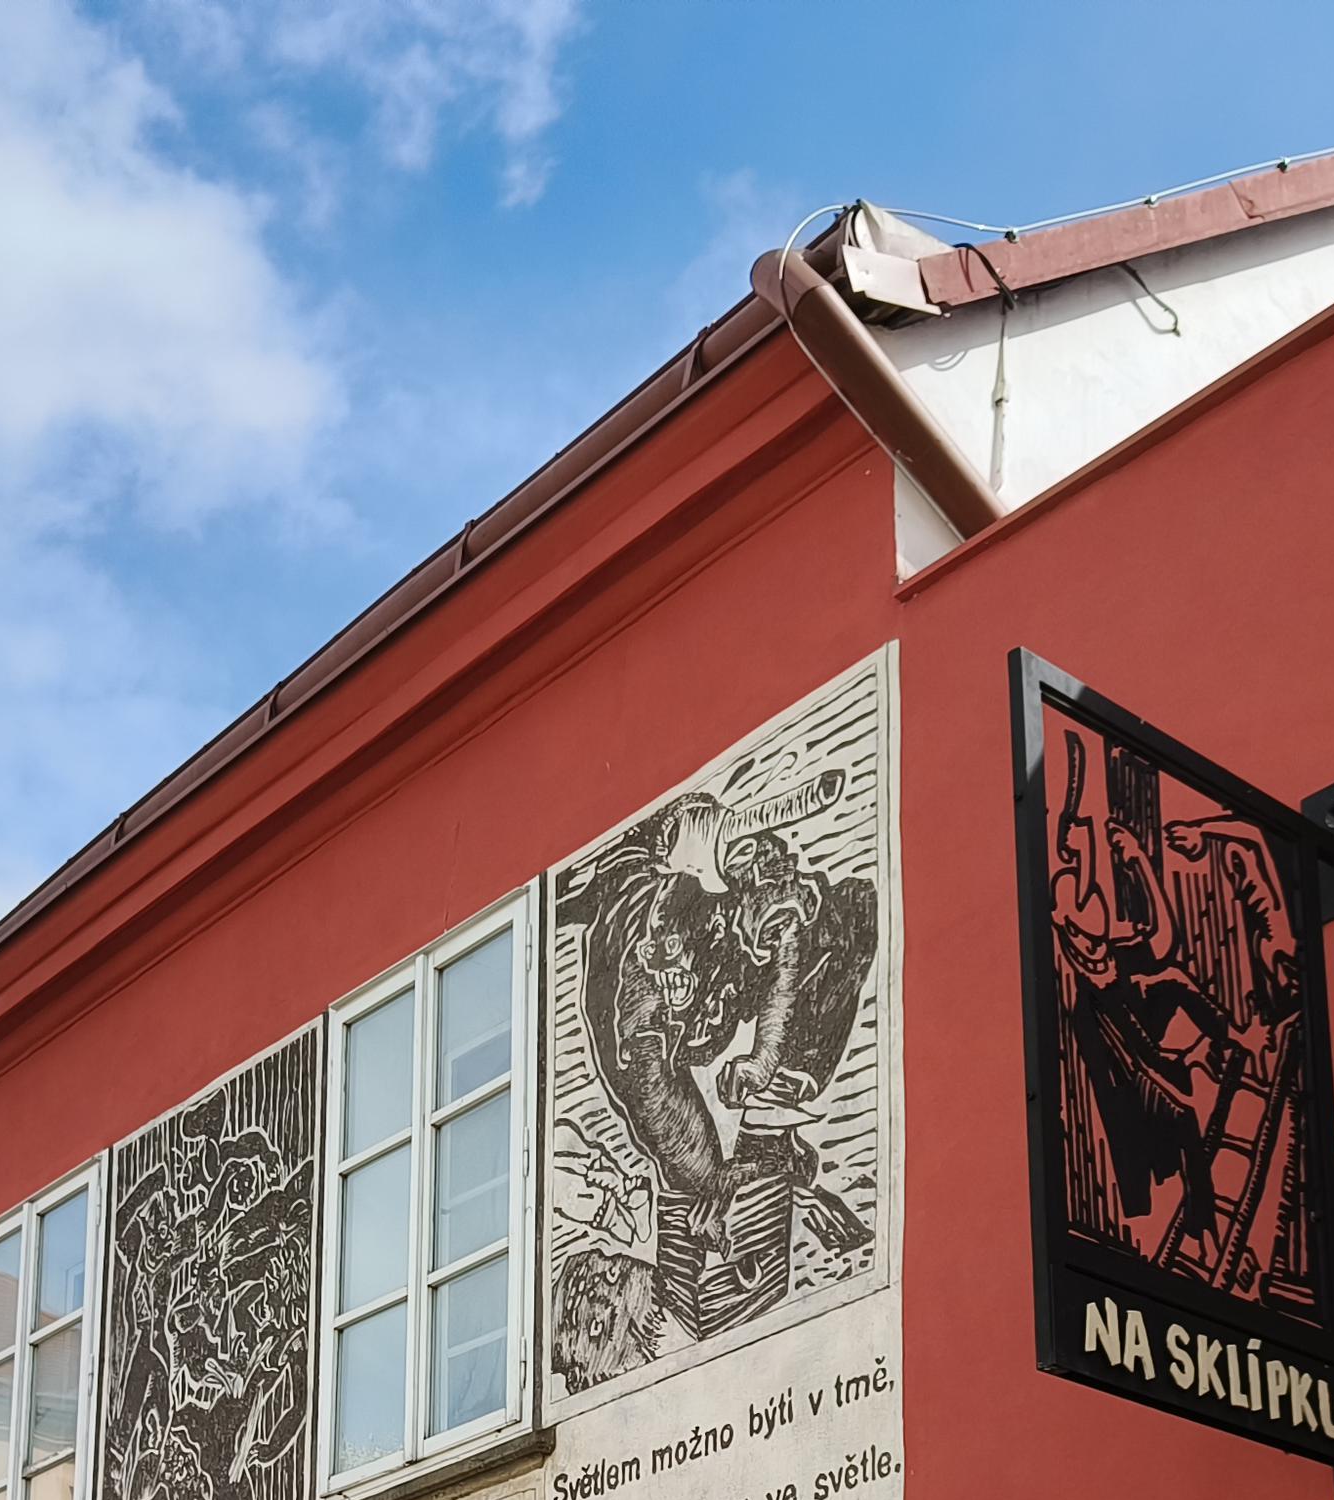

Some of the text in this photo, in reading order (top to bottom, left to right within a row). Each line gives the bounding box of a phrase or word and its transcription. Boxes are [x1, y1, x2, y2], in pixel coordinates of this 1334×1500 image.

[1084, 1296, 1155, 1381] NA
[652, 1424, 733, 1474] možno
[749, 1387, 793, 1439] býti
[808, 1389, 823, 1416] v
[835, 1356, 895, 1408] tmě,
[814, 1444, 901, 1500] světle.
